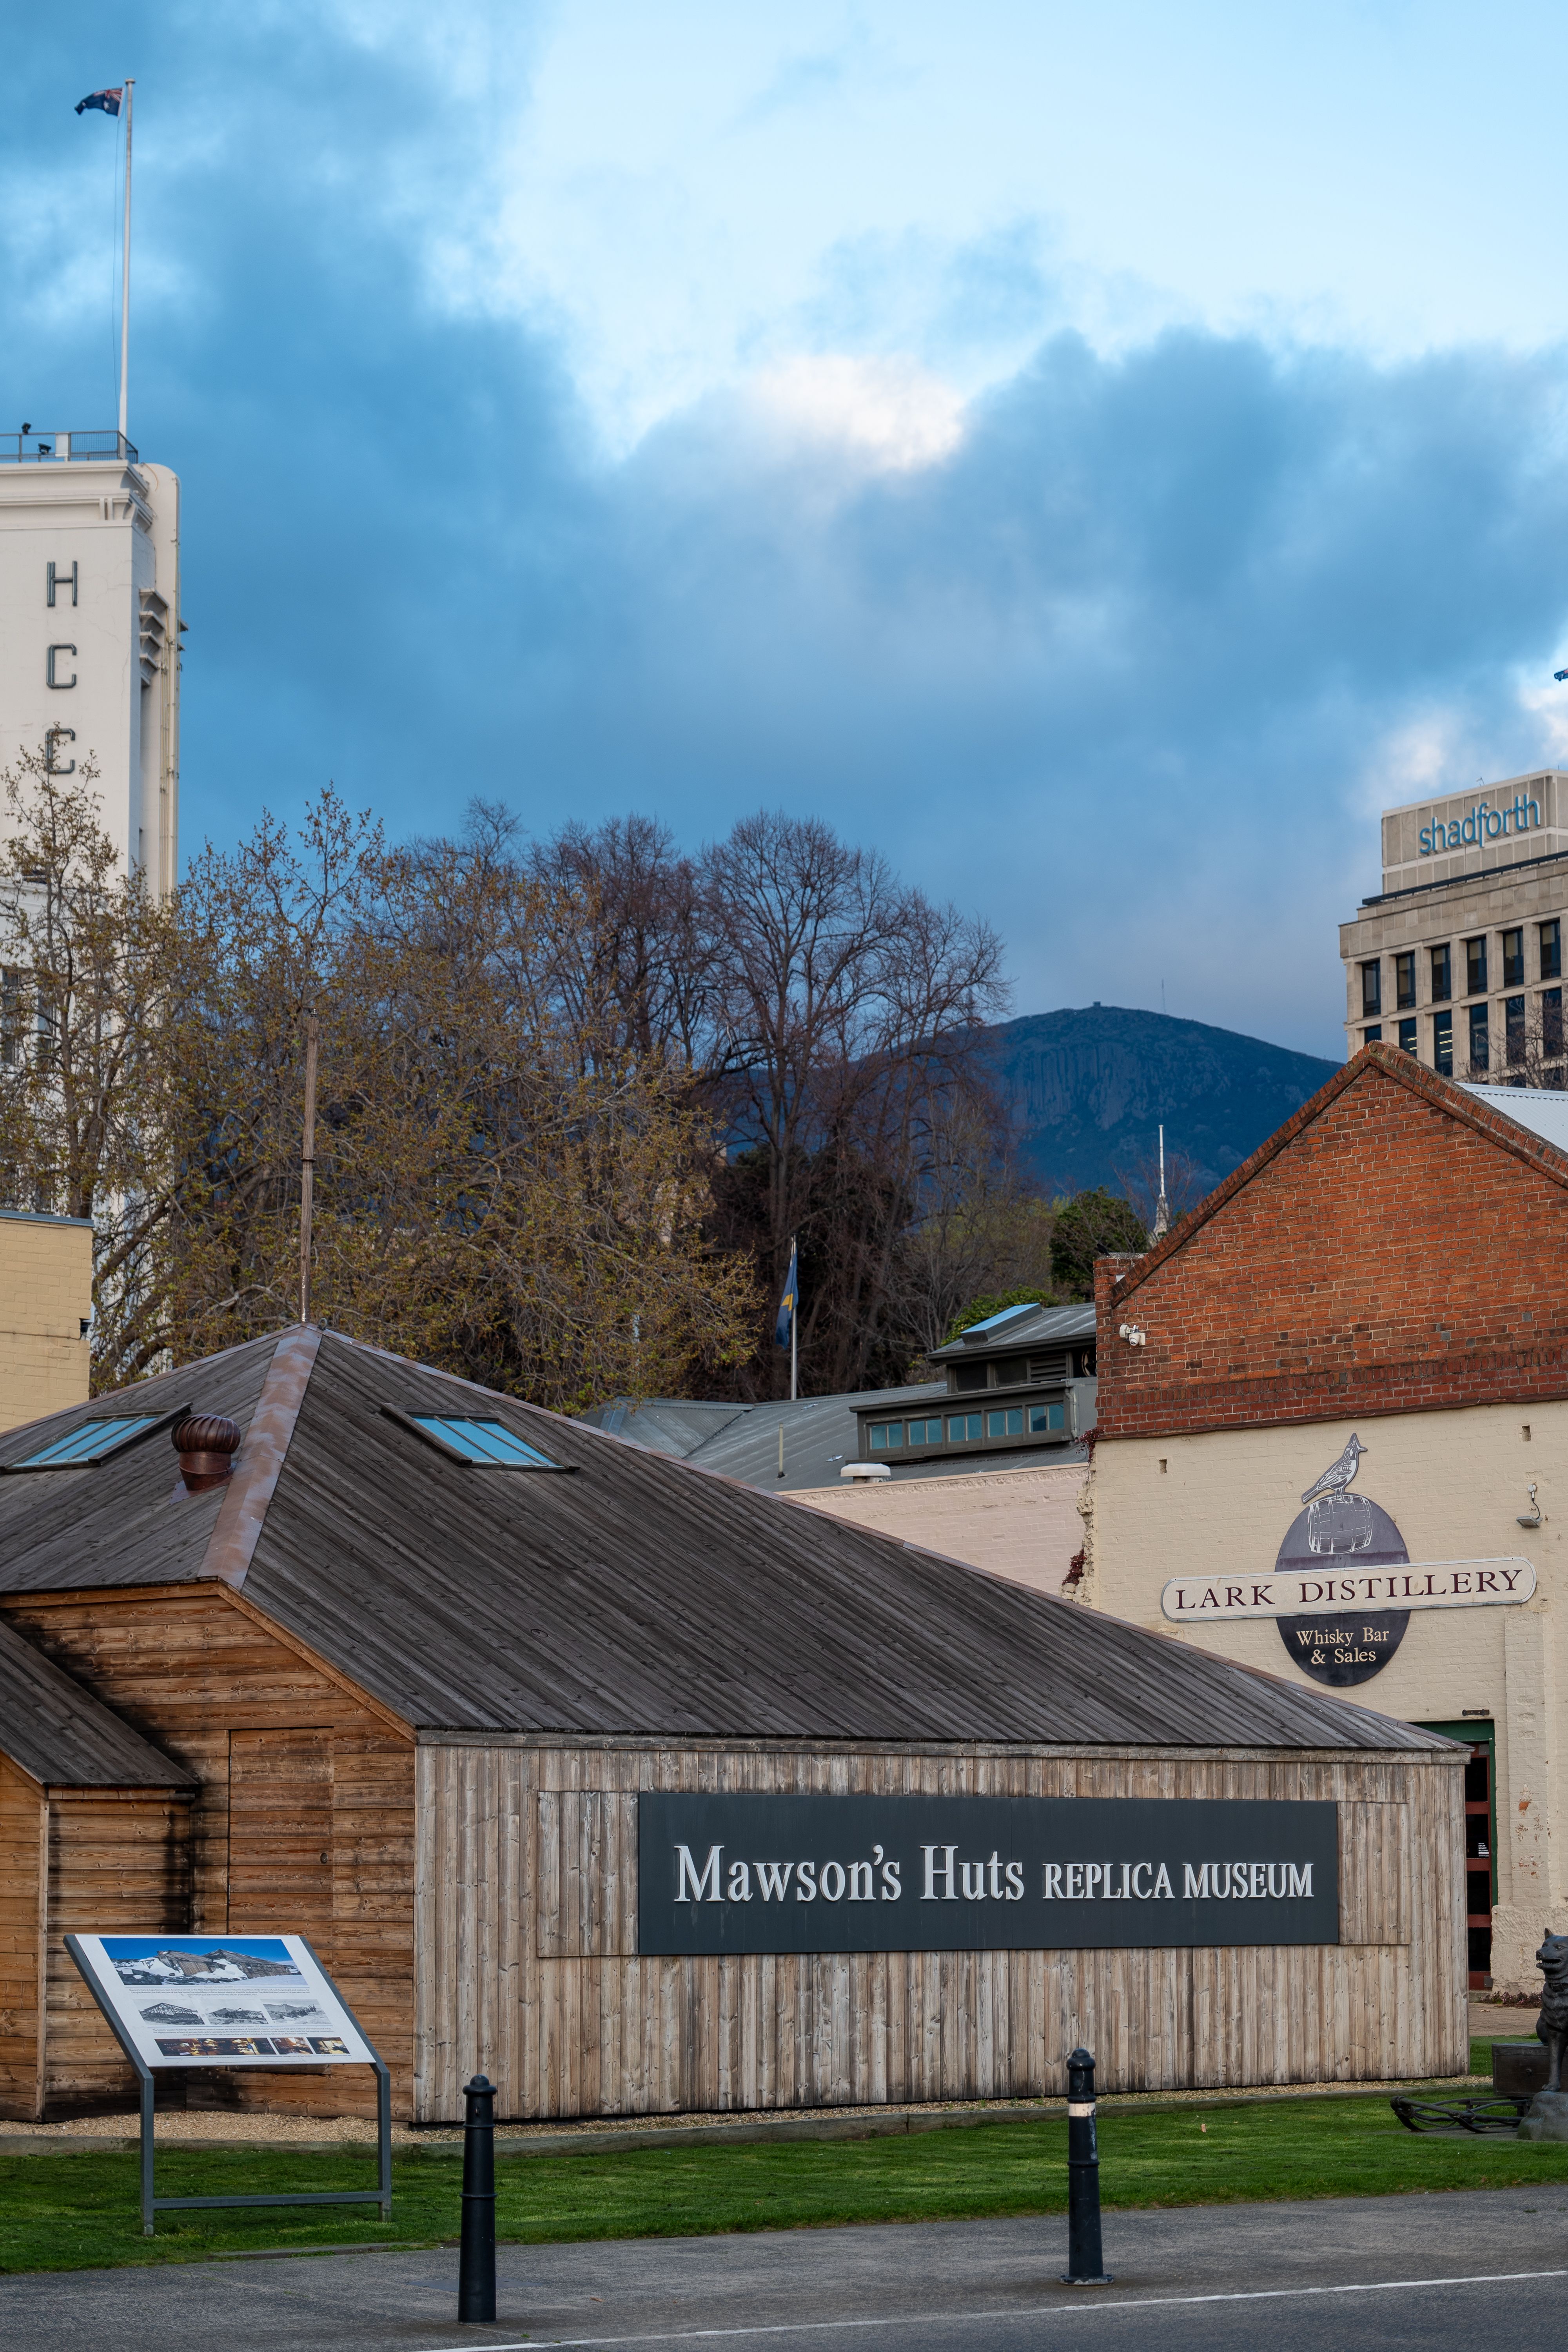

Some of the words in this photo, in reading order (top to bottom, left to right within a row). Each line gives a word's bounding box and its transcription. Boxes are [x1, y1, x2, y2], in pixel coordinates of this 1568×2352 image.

[1419, 793, 1541, 853] shadforth
[1176, 1584, 1276, 1610] LARK
[1298, 1569, 1523, 1603] DISTILLERY
[1296, 1628, 1354, 1646] Whisky
[1362, 1627, 1390, 1642] Bar
[1311, 1649, 1326, 1664] &
[1334, 1647, 1376, 1663] Sales
[674, 1844, 902, 1902] Mawson's
[920, 1846, 1024, 1900] Huts
[1042, 1862, 1176, 1899] REPLICA
[1182, 1862, 1314, 1899] MUSEUM
